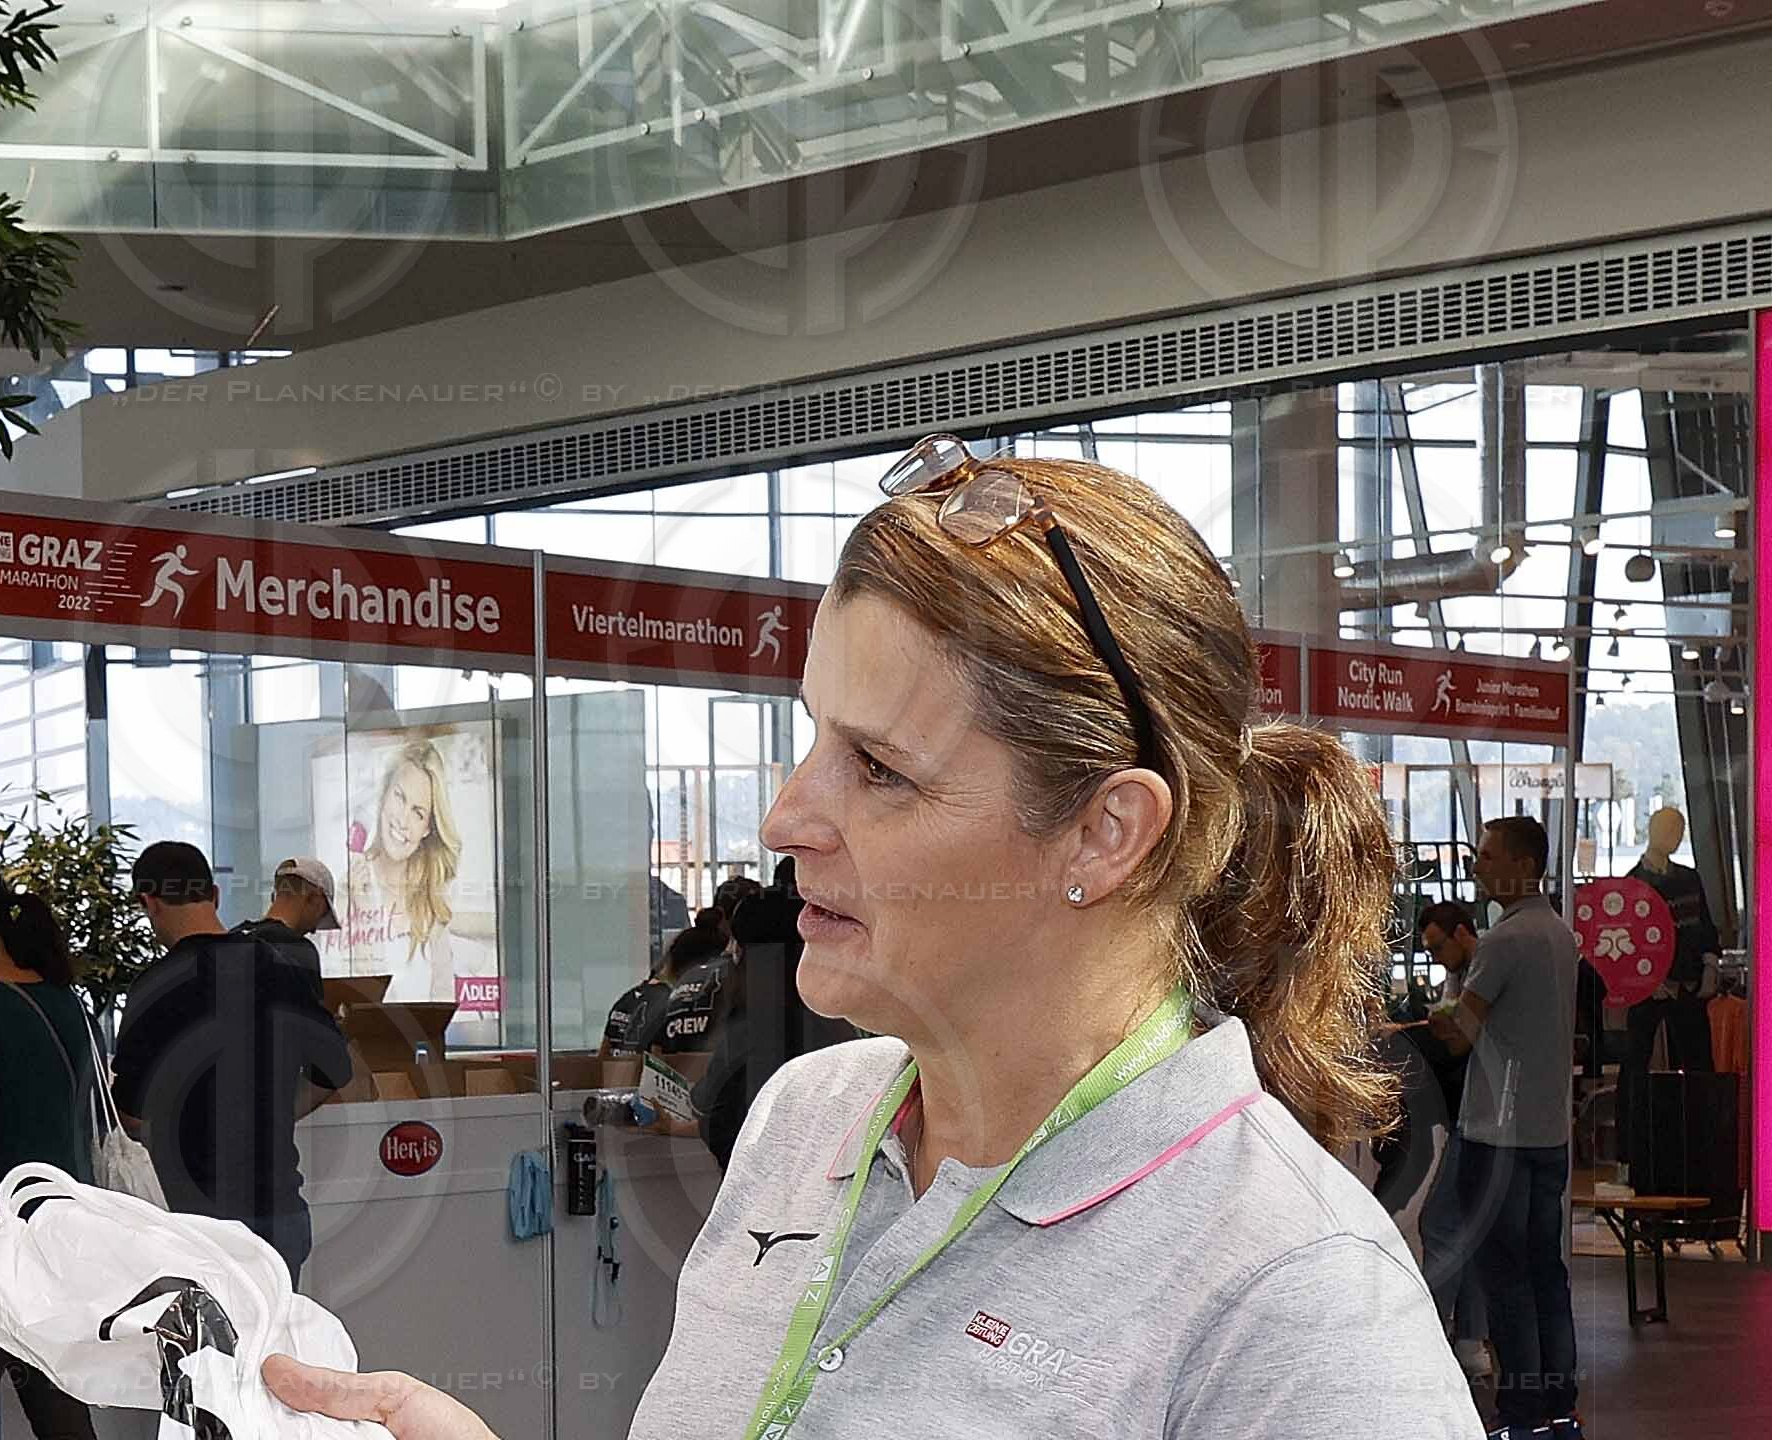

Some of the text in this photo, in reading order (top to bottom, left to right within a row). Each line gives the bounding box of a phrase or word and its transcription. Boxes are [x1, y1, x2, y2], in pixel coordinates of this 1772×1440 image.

[18, 534, 103, 571] GRAZ
[0, 569, 78, 590] MARATHON
[58, 594, 91, 610] 2022
[216, 557, 500, 633] Merchandise
[572, 604, 743, 647] Viertelmarathon
[1349, 659, 1403, 687] City Run
[1338, 687, 1414, 713] Nordic Walk
[459, 981, 499, 1002] ADLER
[666, 1015, 709, 1039] CREW
[386, 1135, 439, 1164] Hervis
[967, 1323, 1003, 1346] ZEITUNG
[973, 1312, 1010, 1338] KLEINE
[1008, 1332, 1077, 1378] GRAZ
